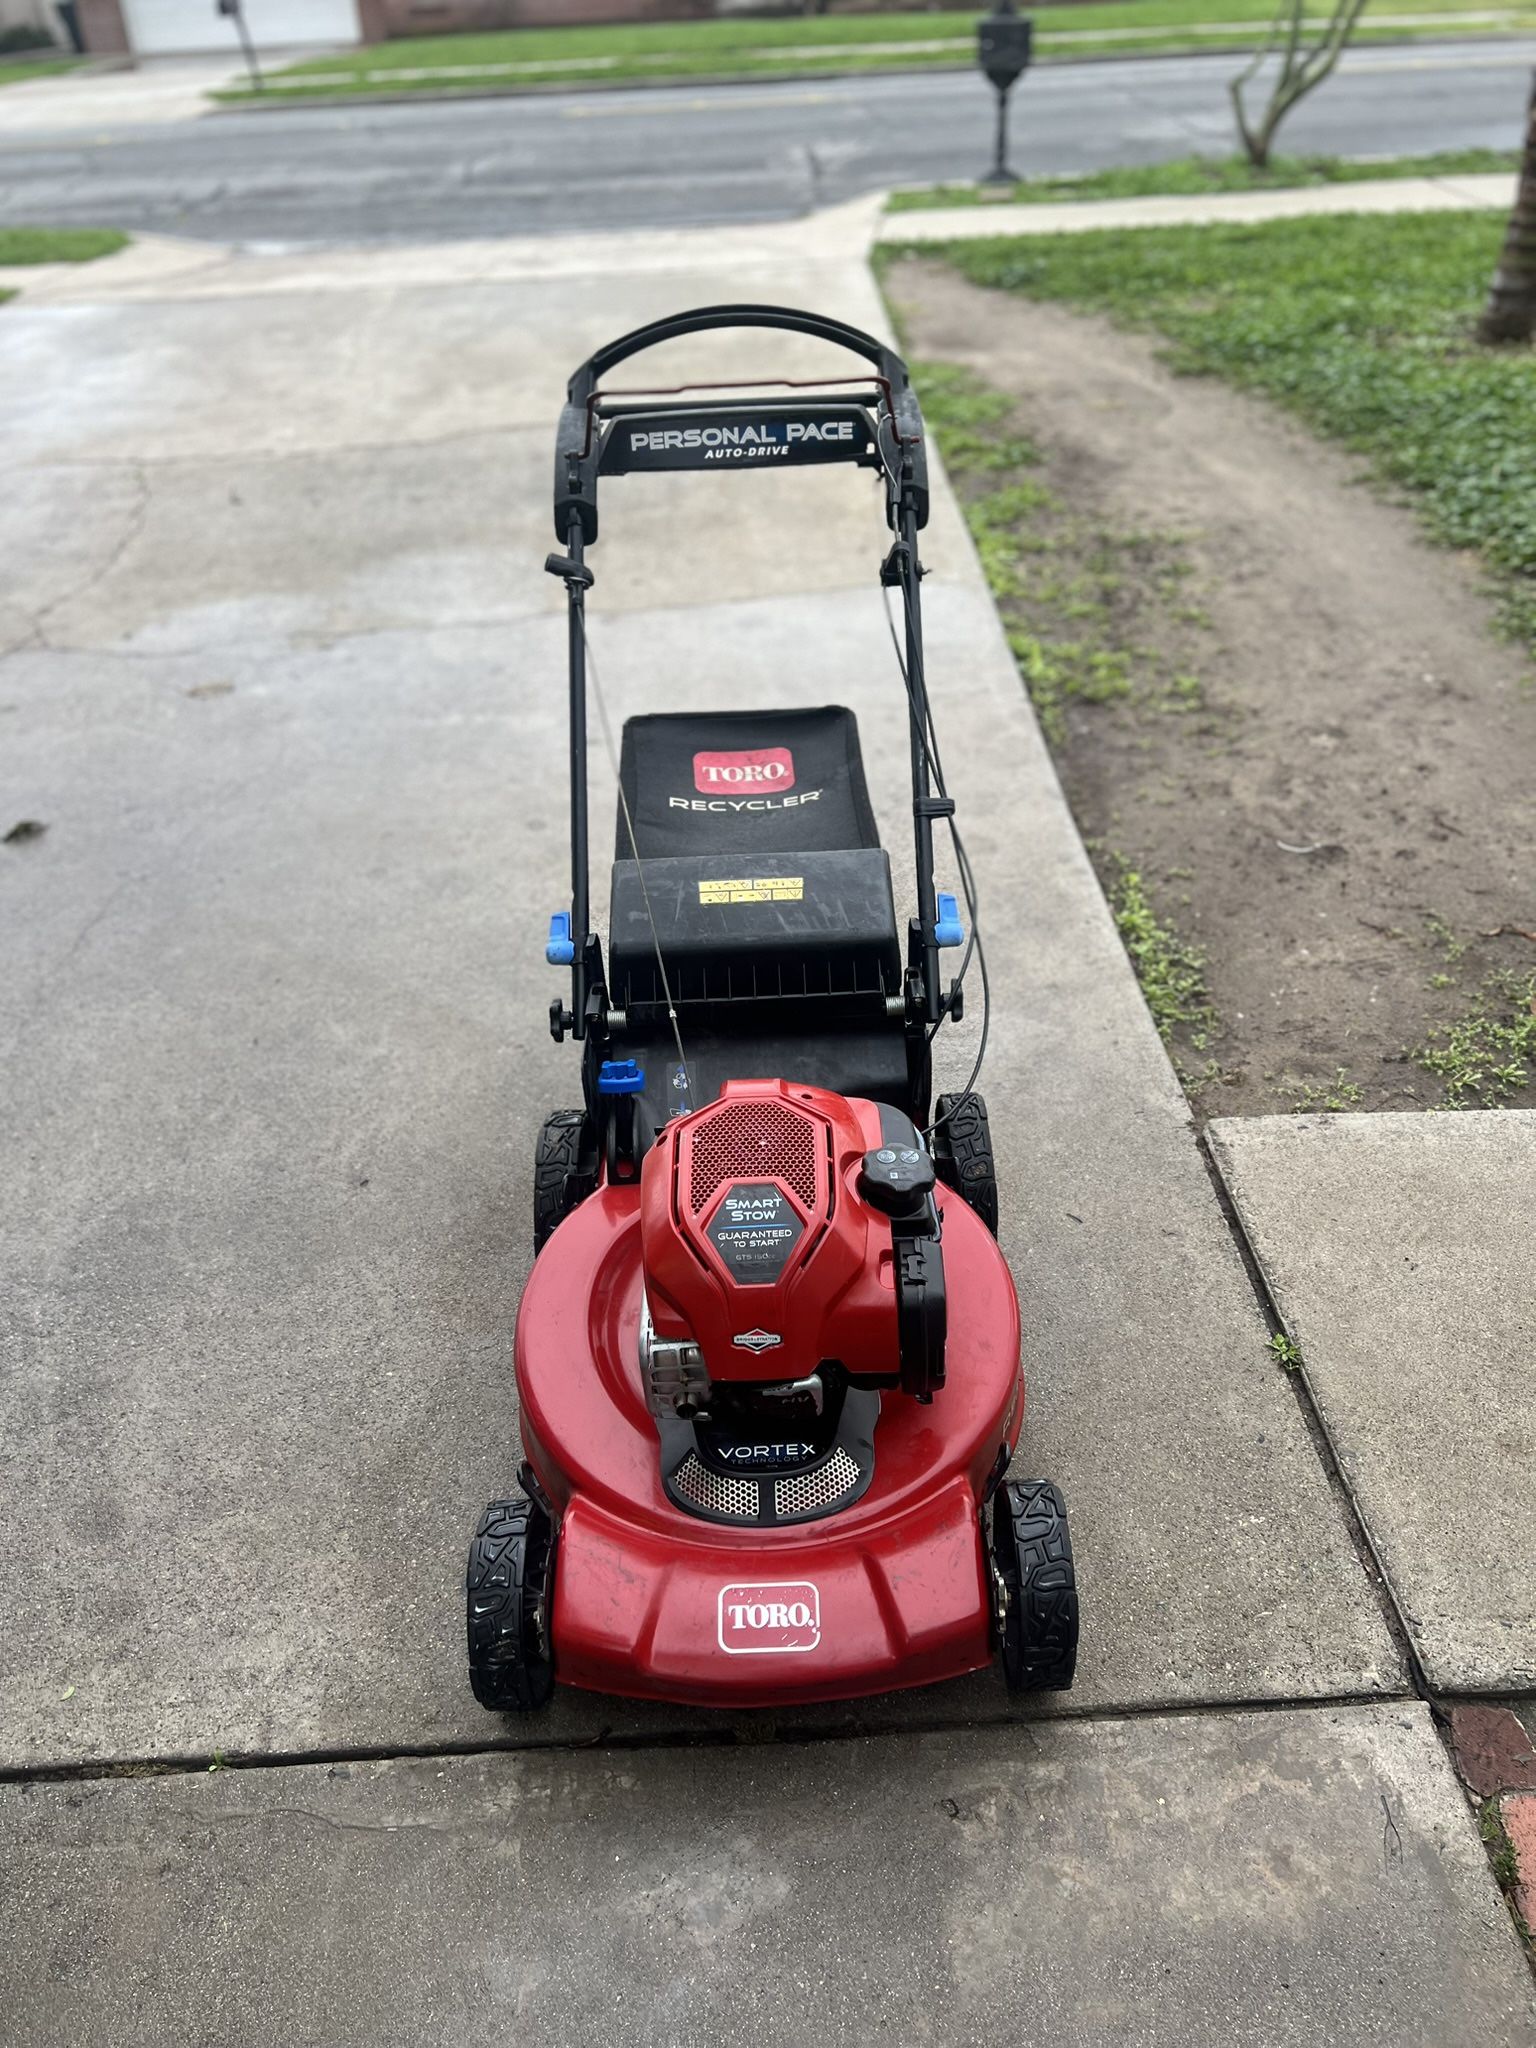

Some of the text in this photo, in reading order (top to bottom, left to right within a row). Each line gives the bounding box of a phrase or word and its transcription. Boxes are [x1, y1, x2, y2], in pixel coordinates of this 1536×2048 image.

[630, 422, 854, 451] PERSONAL PACE
[704, 445, 790, 459] AUTO-DRIVE
[702, 762, 786, 782] TORO
[669, 790, 822, 812] RECYCLER
[725, 1198, 782, 1210] SMART
[731, 1210, 776, 1222] STOW
[718, 1229, 792, 1240] GUARANTEED
[749, 1239, 778, 1248] START
[718, 1443, 816, 1459] VORTEX
[731, 1456, 807, 1465] TECHNOLOGY
